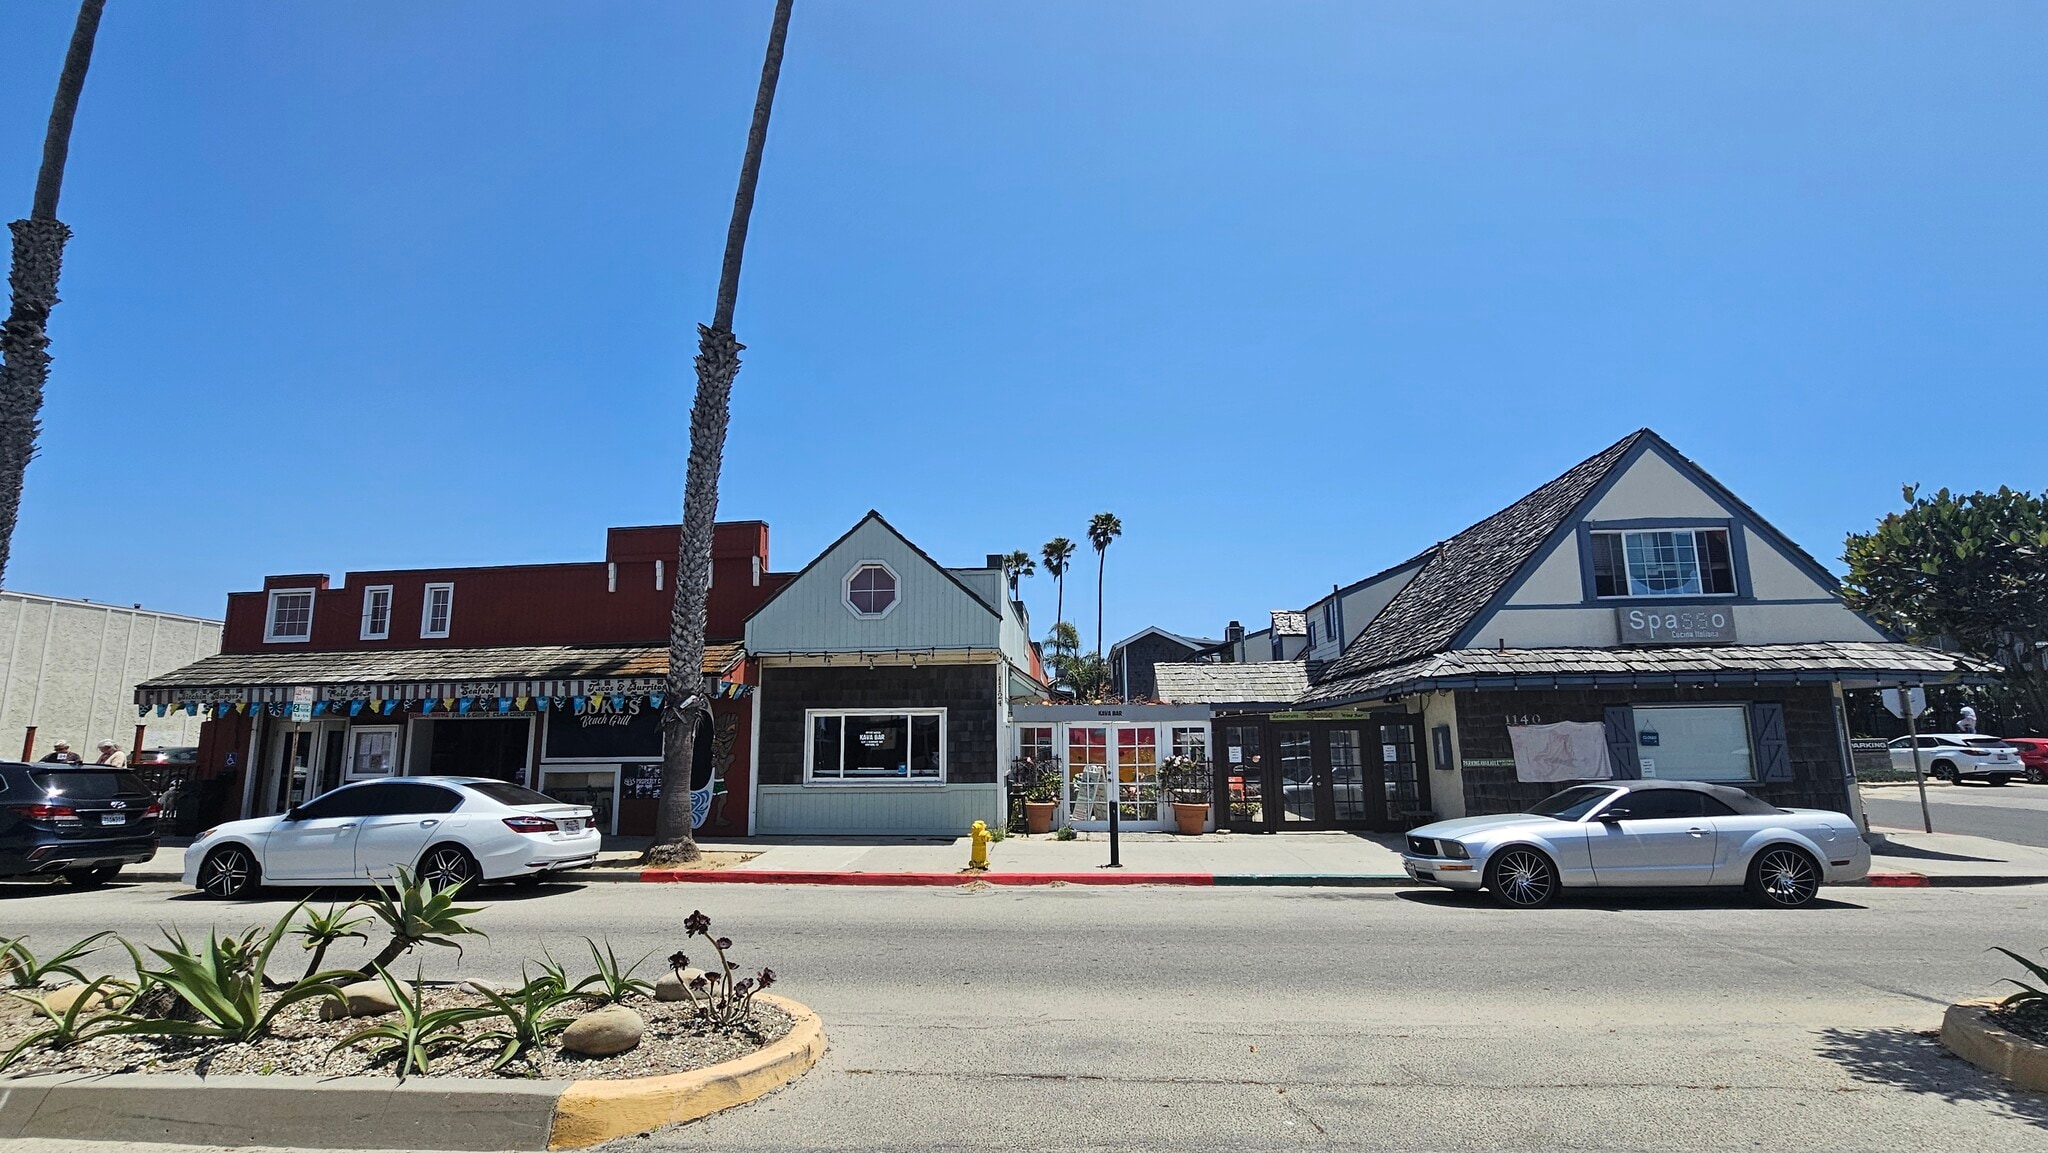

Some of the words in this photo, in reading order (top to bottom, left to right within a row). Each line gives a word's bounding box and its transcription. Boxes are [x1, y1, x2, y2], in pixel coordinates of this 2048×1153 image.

[1629, 610, 1725, 638] Spasso
[1671, 630, 1694, 638] Cucina
[1695, 630, 1719, 638] Italiana
[461, 684, 498, 697] Seafood
[587, 681, 614, 693] Tacos
[627, 682, 666, 693] Burritos
[580, 714, 608, 728] Beach
[609, 714, 632, 727] Grill
[1505, 714, 1540, 725] 1140
